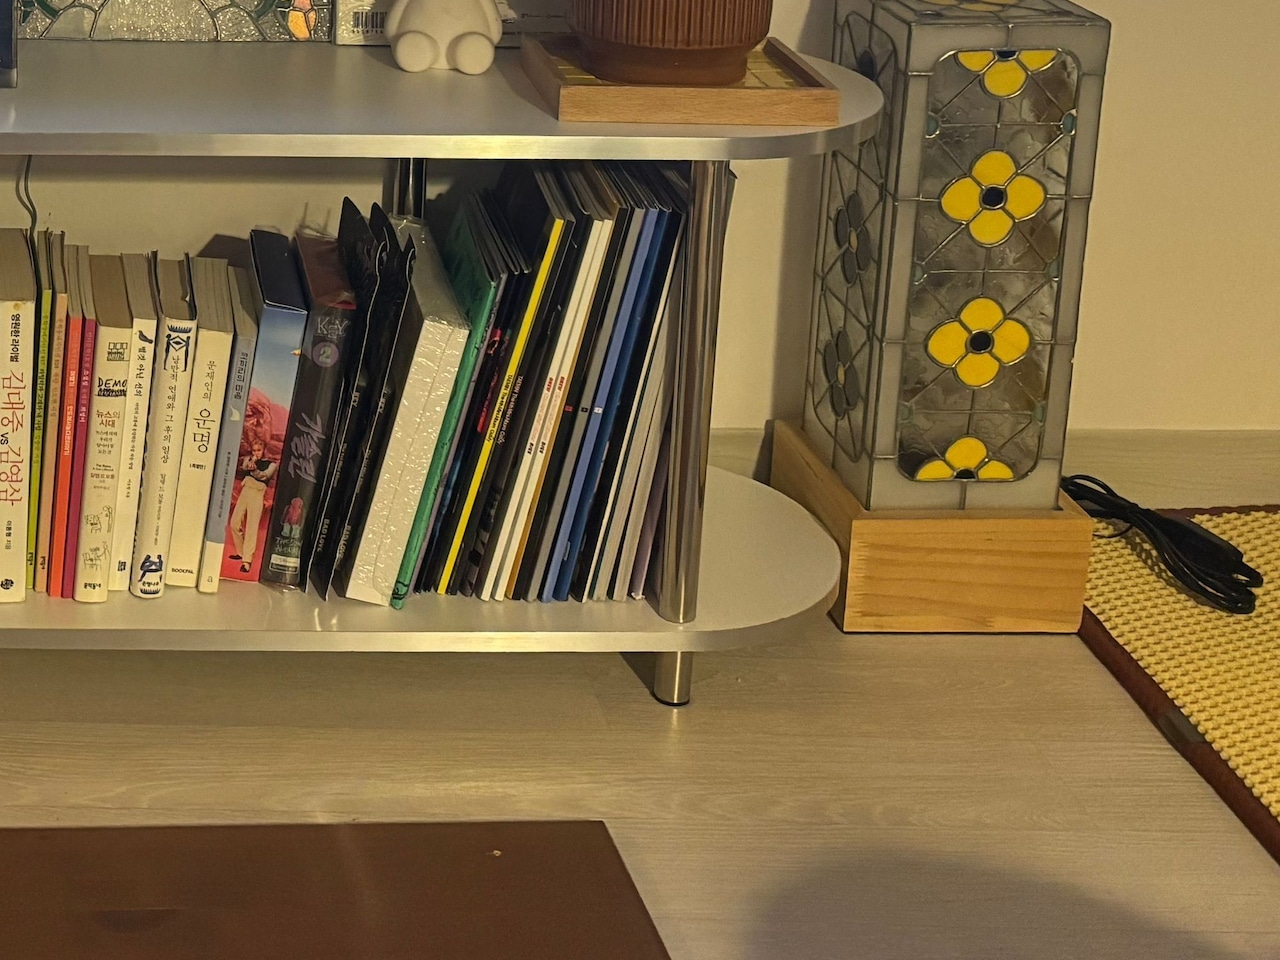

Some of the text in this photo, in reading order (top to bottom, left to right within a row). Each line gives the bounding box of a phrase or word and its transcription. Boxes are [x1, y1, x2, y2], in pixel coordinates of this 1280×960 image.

[9, 313, 21, 363] 영원한 라이벌
[319, 346, 332, 363] 2
[133, 346, 147, 397] 별것 아닌 선의
[98, 376, 127, 388] DEMO
[202, 360, 217, 402] 문재인의
[503, 374, 513, 390] TAEMIN
[513, 375, 523, 392] TAEMIN
[0, 369, 26, 434] 김대중
[161, 355, 180, 464] 낭만적 연애와 그 후의 일상
[96, 409, 120, 419] 뉴스의
[99, 419, 115, 428] 시대
[193, 408, 216, 453] 운명
[171, 567, 194, 575] BOOKPAL
